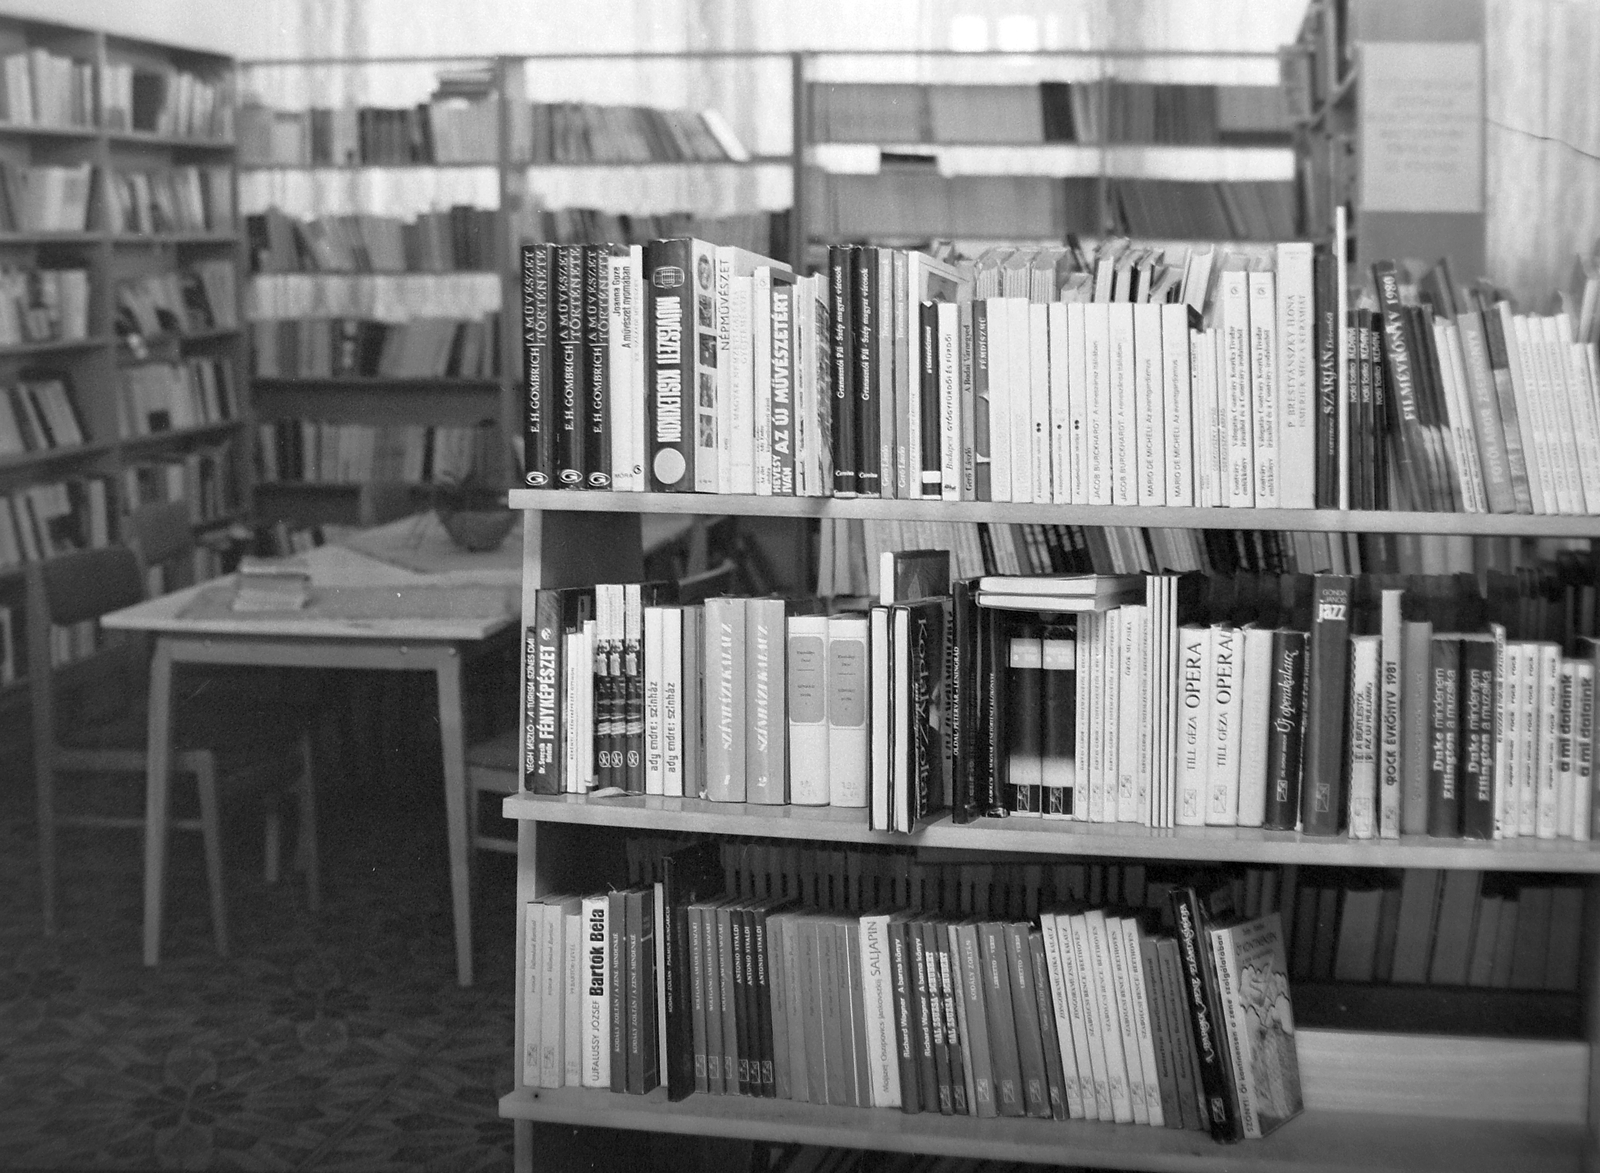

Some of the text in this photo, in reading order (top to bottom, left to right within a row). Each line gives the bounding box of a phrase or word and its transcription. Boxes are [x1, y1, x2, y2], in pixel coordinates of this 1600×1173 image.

[535, 249, 547, 342] TÖRTÉNETE
[569, 248, 581, 340] TÖRTÉNETE
[597, 249, 609, 342] TÖRTÉNETE
[613, 287, 621, 317] Joanna
[622, 266, 632, 305] nyomában
[1381, 276, 1399, 305] 1980
[621, 306, 631, 341] művészet
[718, 259, 730, 351] NÉPMŰVÉSZET
[525, 332, 534, 341] A
[560, 330, 568, 339] A
[589, 332, 597, 341] A
[833, 265, 846, 399] Granasztói Pál Szép magyar városok
[859, 267, 871, 400] Granasztói Pál Szép magyar városok
[530, 347, 540, 409] GOMBRICH
[564, 345, 574, 407] GOMBRICH
[593, 347, 602, 410] GOMBRICH
[655, 370, 681, 443] KISLEXIKON
[772, 408, 789, 426] ÚJ
[774, 430, 789, 454] AZ
[772, 455, 791, 493] HEVESY IVÁN
[1316, 599, 1346, 623] jazz
[1322, 589, 1348, 597] GONDA
[916, 618, 929, 718] Kodály
[1386, 661, 1397, 685] 1981
[537, 645, 555, 739] FÉNYKÉPÉSZET
[1185, 643, 1201, 771] TILL GÉZA OPERA
[1274, 650, 1299, 732] Új operakalauz
[1445, 669, 1456, 718] muzsika
[526, 724, 535, 750] LÁSZLÓ
[1216, 712, 1228, 741] GÉZA
[1432, 668, 1444, 771] Duke mindenem
[1468, 669, 1480, 773] Duke mindenem
[1478, 670, 1493, 802] Ellington a muzsika
[1559, 674, 1572, 772] a mi dalaink
[1579, 677, 1592, 777] a mi dalaink
[526, 752, 535, 774] VÉGH
[649, 753, 661, 771] ady
[666, 755, 678, 773] ady
[1217, 744, 1227, 767] TILL
[1385, 750, 1398, 786] ROCK
[1443, 732, 1457, 800] Ellington
[589, 908, 604, 996] Bartók Béla
[867, 921, 882, 977] SALJAPIN
[894, 938, 903, 962] könyv
[915, 937, 924, 961] könyv
[1217, 934, 1234, 995] szolgálatában
[590, 1000, 600, 1032] JÓZSEF
[900, 997, 909, 1027] Wagner
[920, 996, 930, 1026] Wagner
[1227, 999, 1235, 1019] zene
[901, 1029, 910, 1059] Richard
[922, 1027, 931, 1057] Richard
[1231, 1031, 1246, 1081] kontinensen
